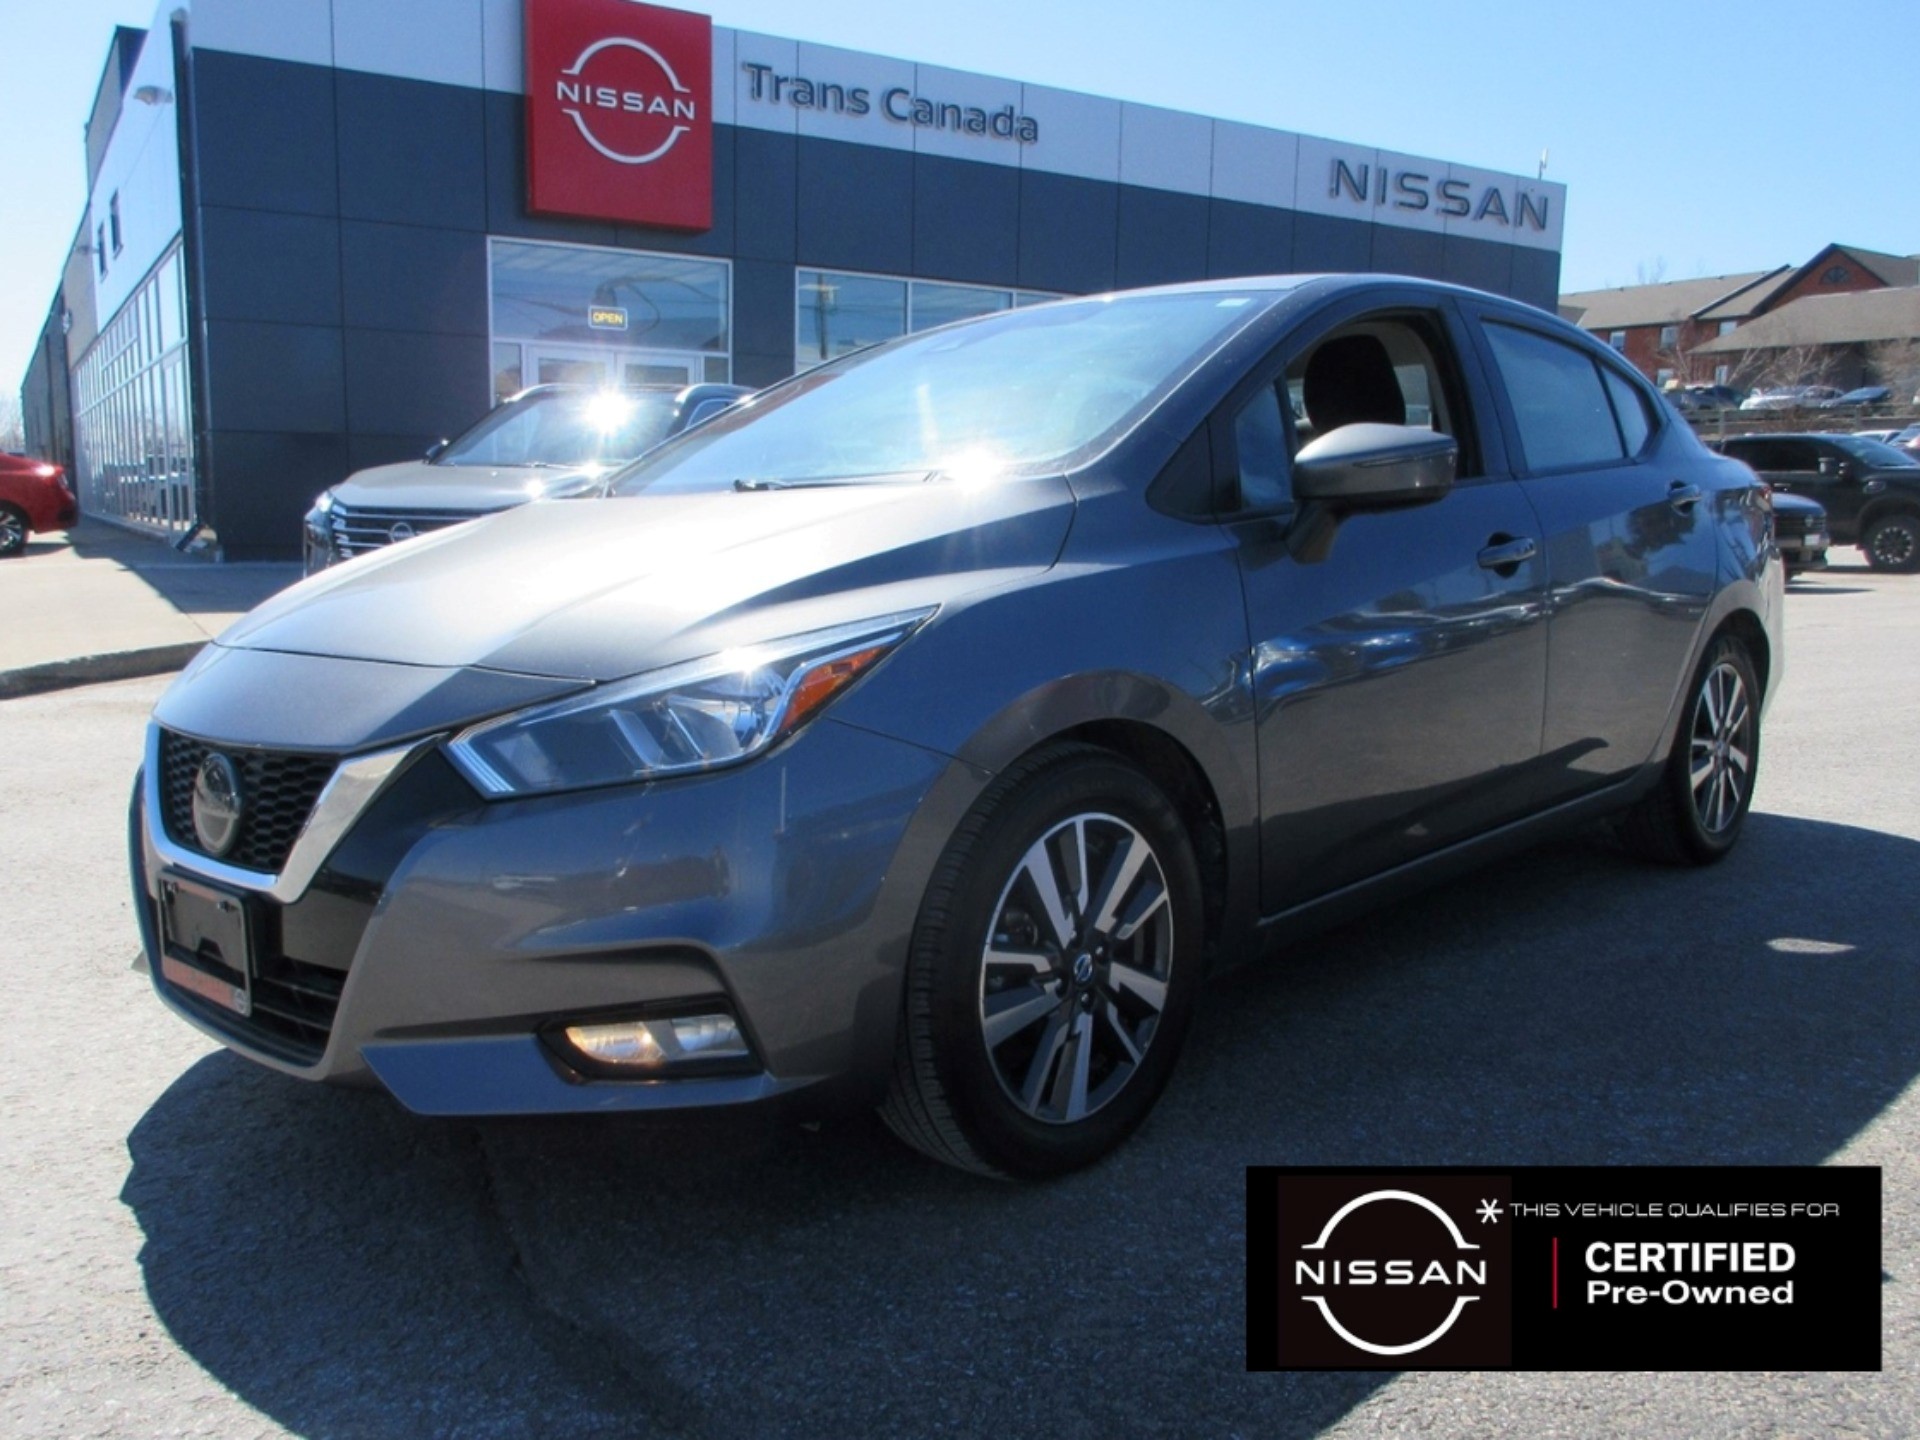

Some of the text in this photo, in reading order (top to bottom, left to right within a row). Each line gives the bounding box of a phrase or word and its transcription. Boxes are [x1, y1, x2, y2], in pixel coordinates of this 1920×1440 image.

[557, 80, 695, 120] NISSAN
[742, 62, 1040, 144] Trans Canada
[1330, 158, 1549, 231] NISSAN
[593, 311, 623, 324] OPEN
